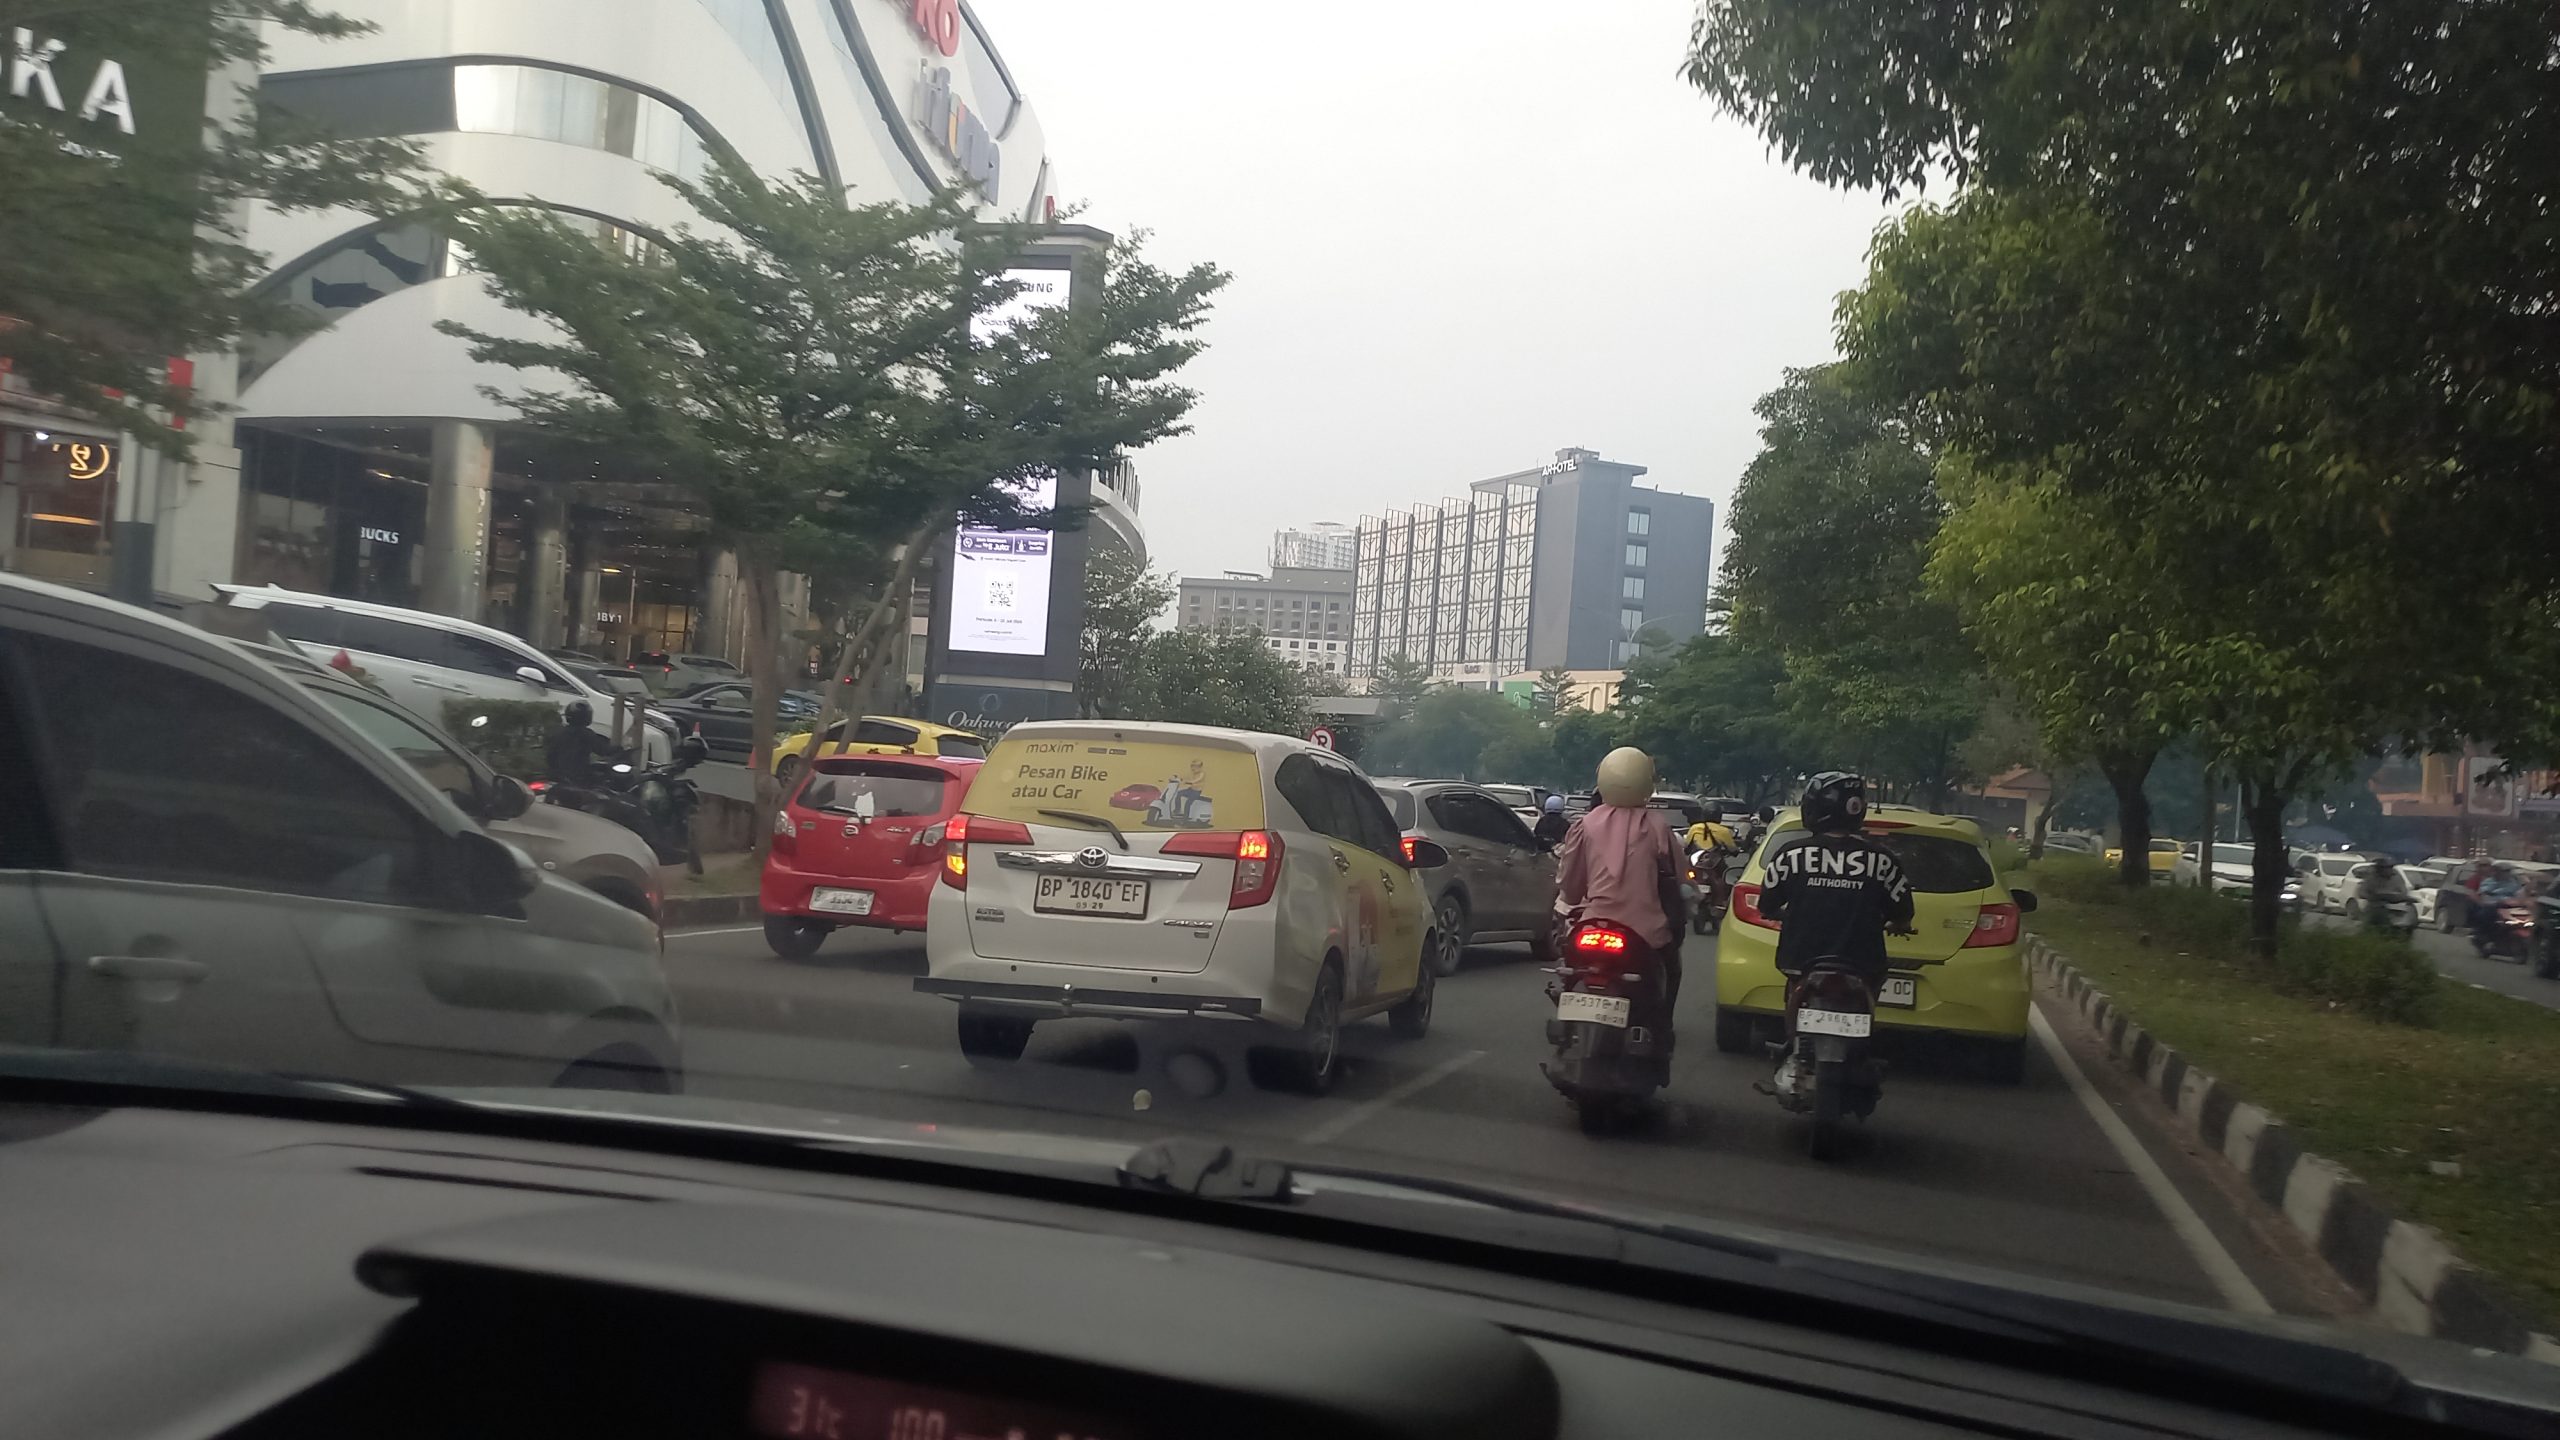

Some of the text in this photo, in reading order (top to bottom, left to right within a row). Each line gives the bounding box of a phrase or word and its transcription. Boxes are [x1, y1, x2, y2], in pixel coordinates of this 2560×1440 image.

[0, 26, 136, 135] KA
[1018, 764, 1108, 781] Pesan Bike
[1012, 784, 1082, 799] atau Car
[1764, 846, 1909, 902] OSTENSIBLE
[1807, 877, 1864, 890] AUTHORITY
[1040, 878, 1143, 902] BP 1840 EF
